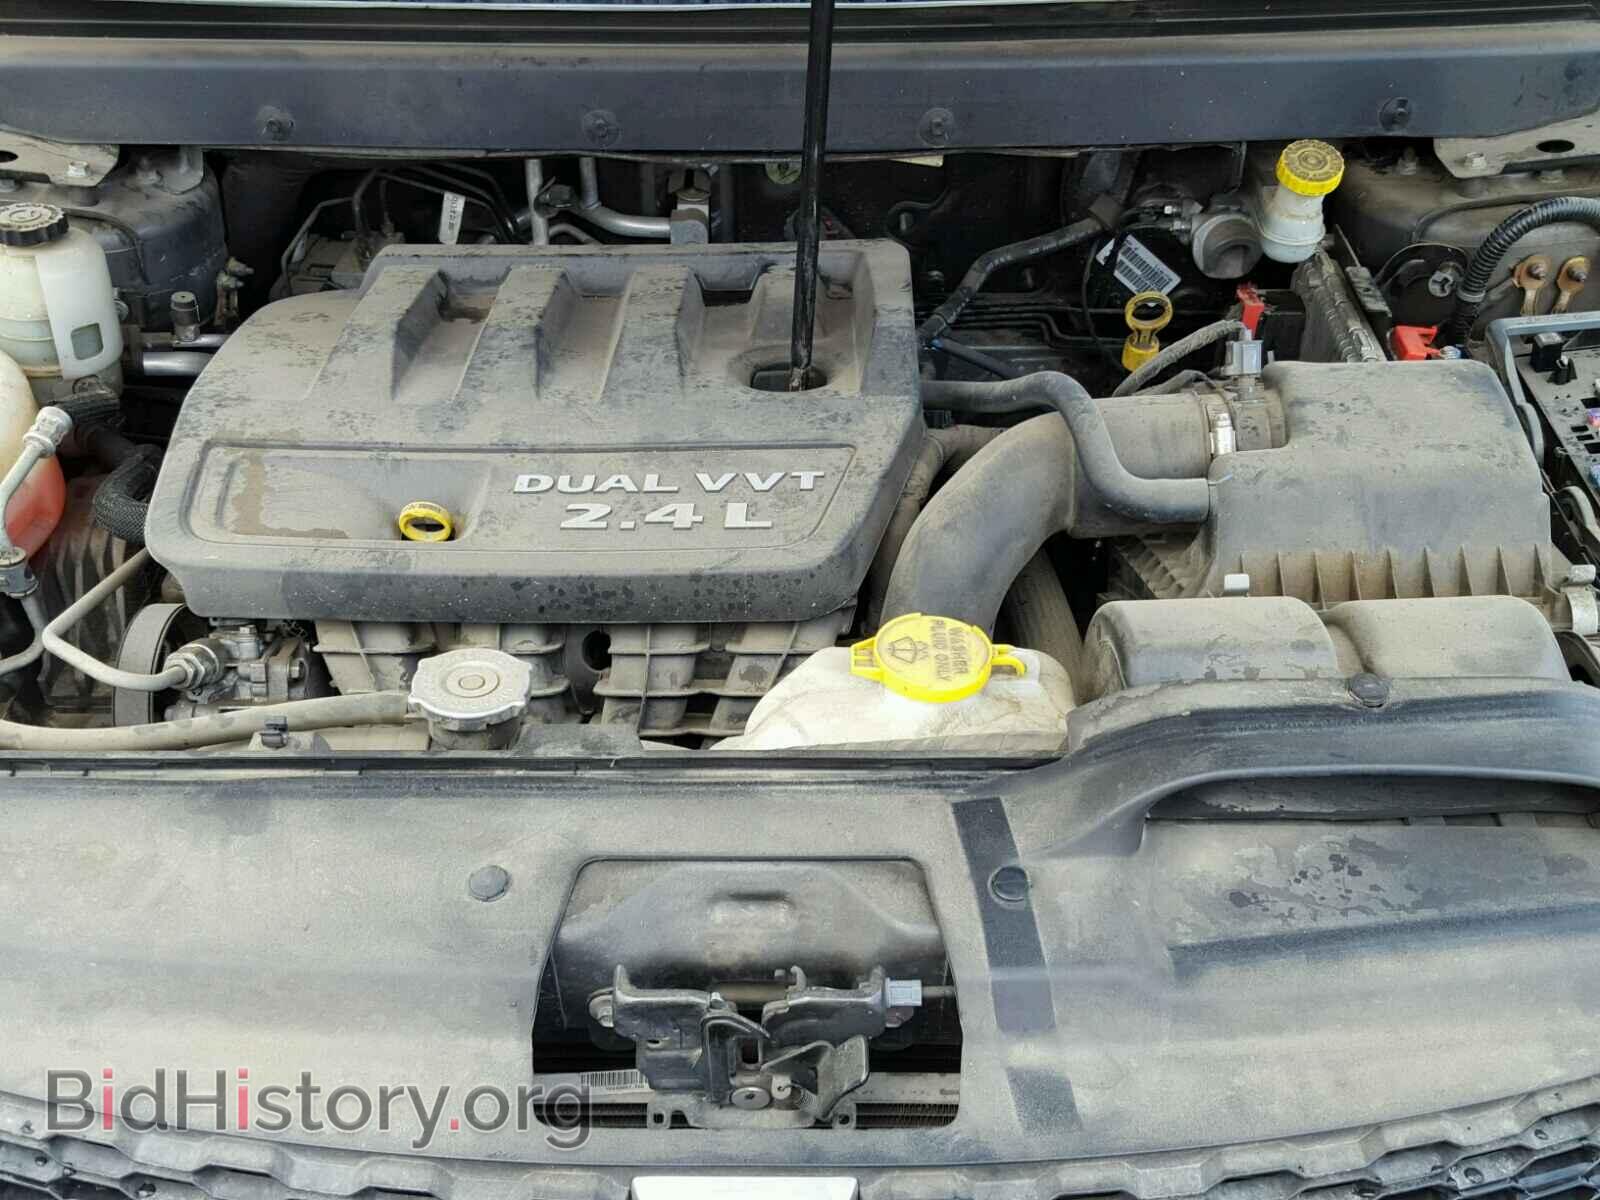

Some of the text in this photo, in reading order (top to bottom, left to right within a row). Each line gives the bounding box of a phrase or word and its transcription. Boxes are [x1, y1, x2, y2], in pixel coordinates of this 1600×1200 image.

[513, 471, 825, 493] DUAL VVT
[560, 502, 773, 529] 2.4 L
[949, 626, 968, 674] WASHER
[935, 653, 952, 681] ONLY
